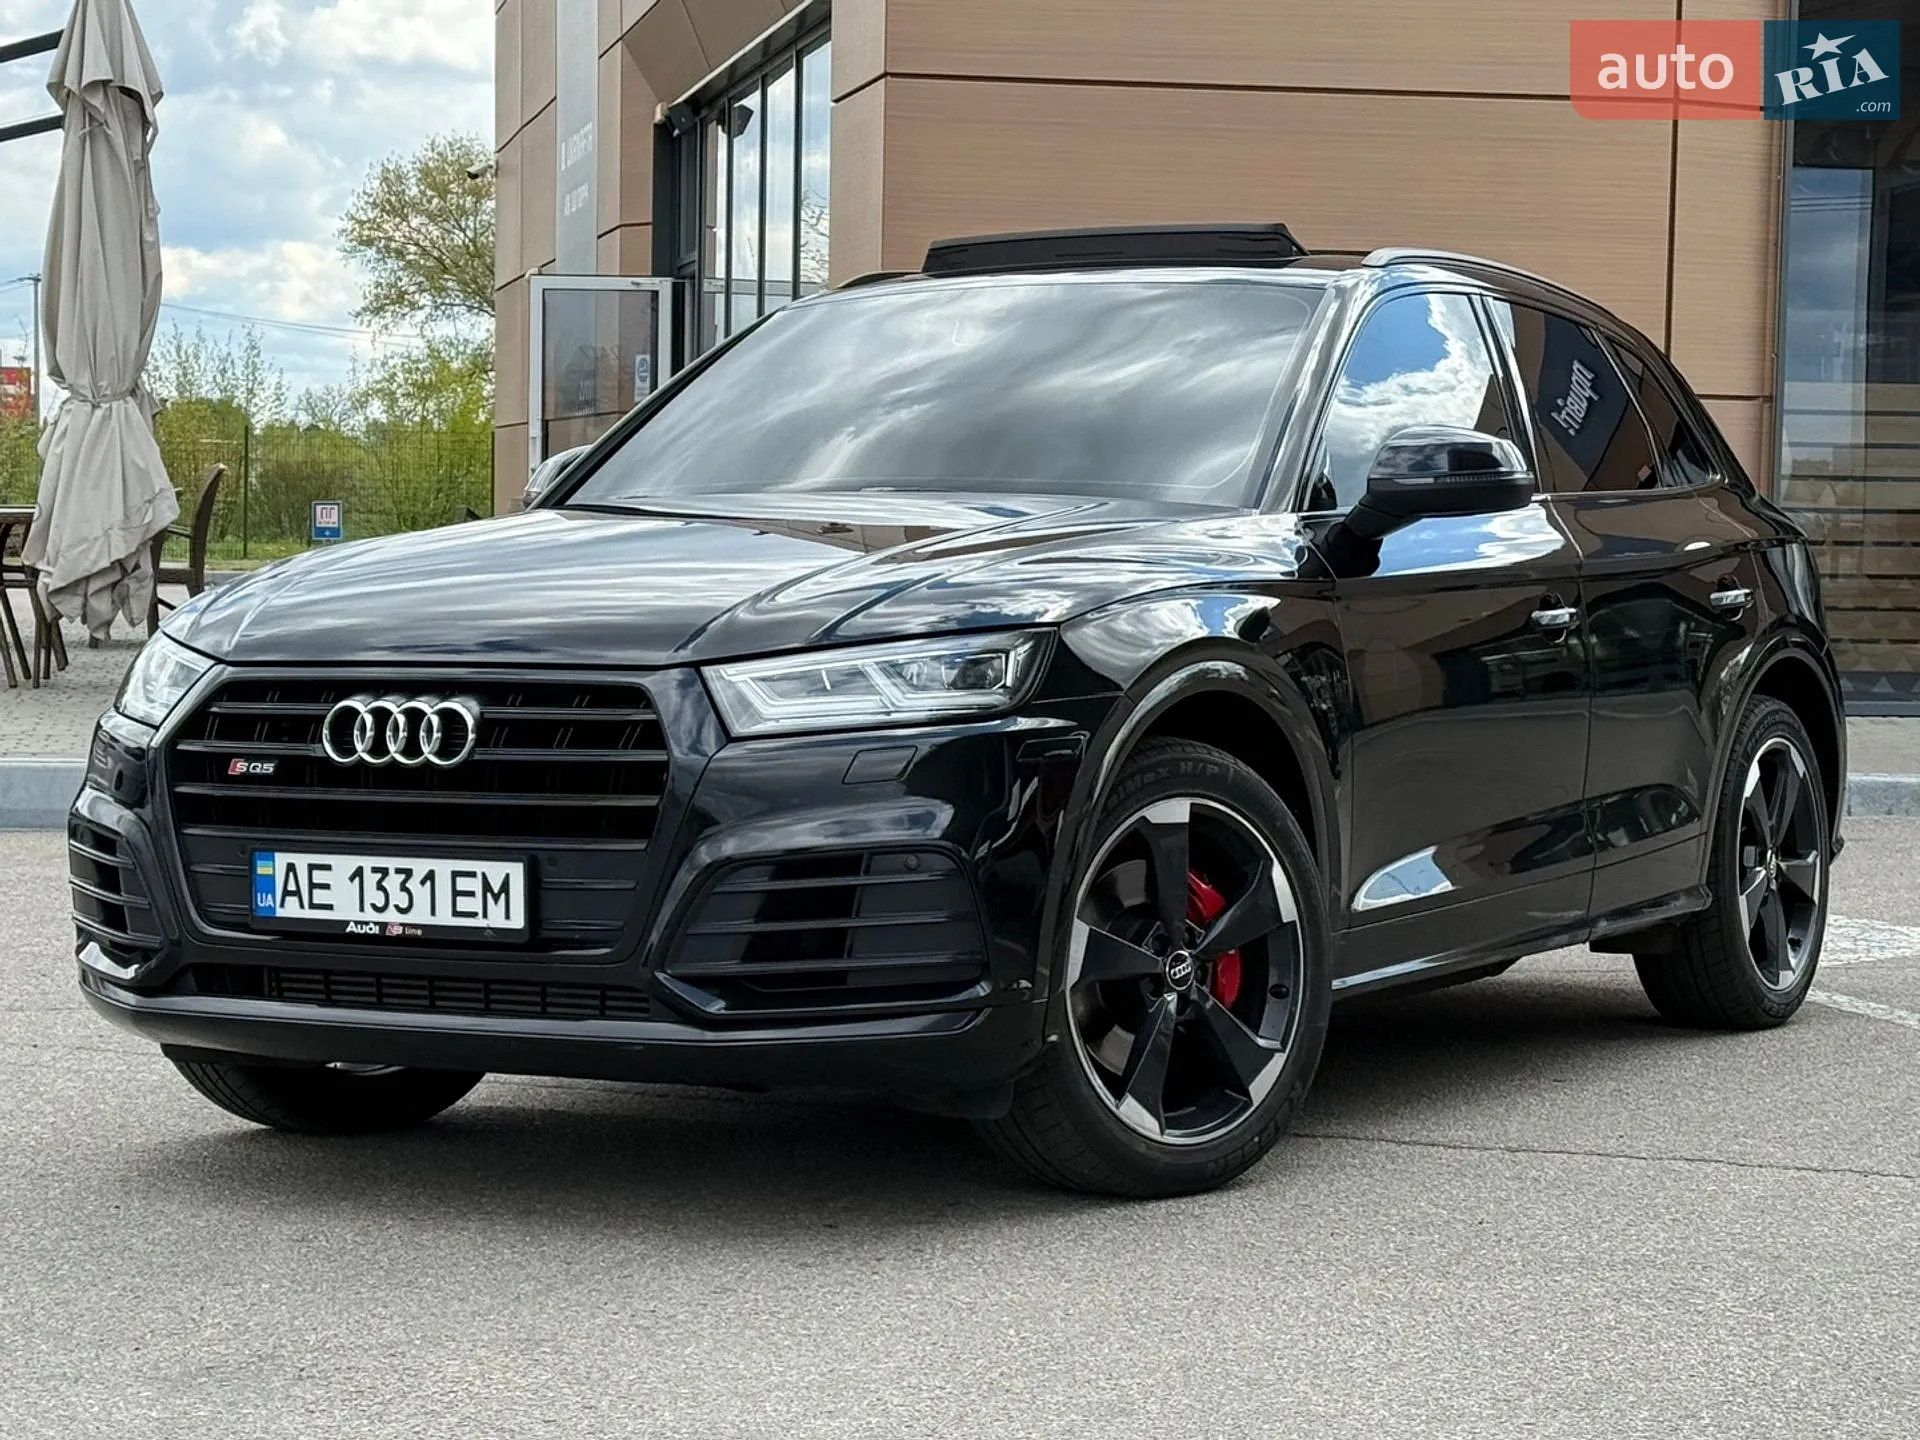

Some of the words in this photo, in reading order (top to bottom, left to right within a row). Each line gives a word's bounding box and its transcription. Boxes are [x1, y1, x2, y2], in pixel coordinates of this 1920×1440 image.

[229, 758, 275, 775] SQ5
[279, 862, 334, 911] AE
[348, 865, 436, 917] 1331
[451, 870, 511, 920] EM
[257, 893, 274, 907] UA
[345, 921, 380, 935] Audi
